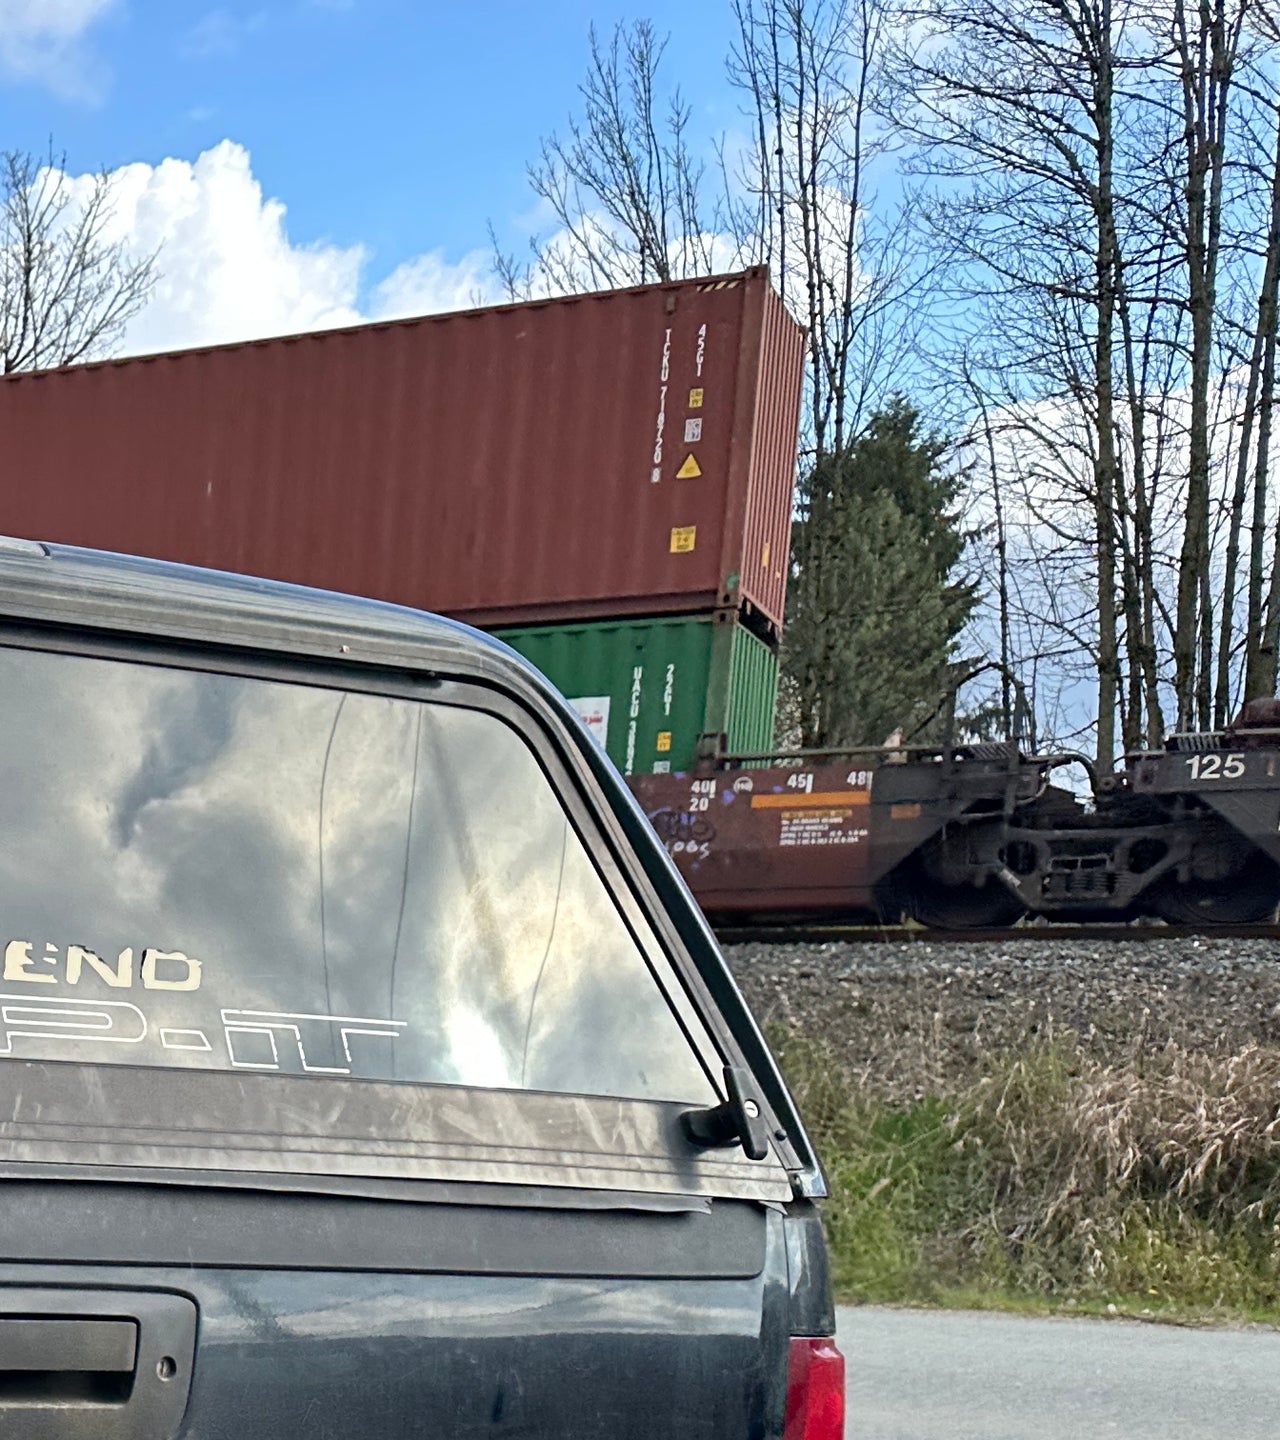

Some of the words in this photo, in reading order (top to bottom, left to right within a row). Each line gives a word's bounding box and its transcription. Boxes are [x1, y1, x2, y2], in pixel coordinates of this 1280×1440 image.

[661, 328, 672, 382] TCKU
[696, 323, 707, 377] 45G1
[630, 666, 643, 718] UACU
[1185, 753, 1246, 780] 125
[691, 779, 711, 794] 40
[787, 773, 806, 789] 45
[846, 770, 867, 786] 48
[689, 797, 709, 812] 20
